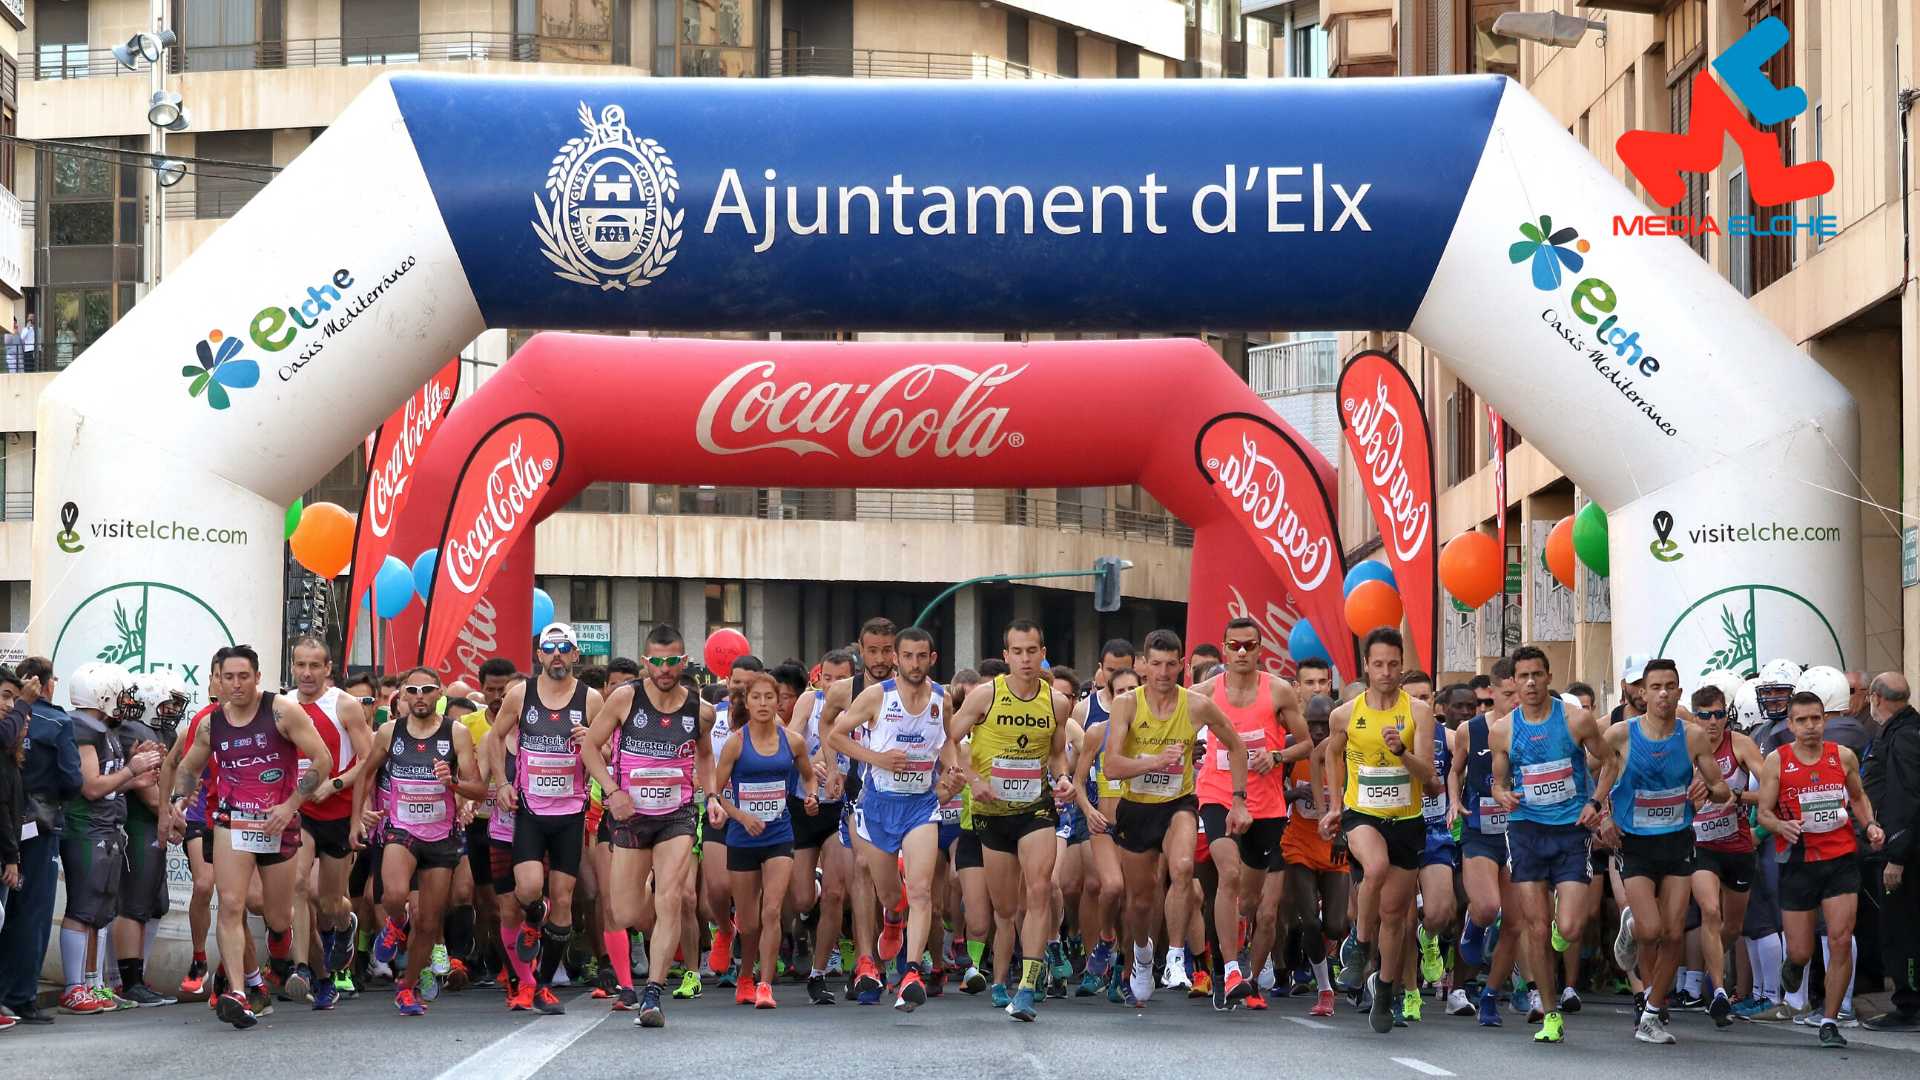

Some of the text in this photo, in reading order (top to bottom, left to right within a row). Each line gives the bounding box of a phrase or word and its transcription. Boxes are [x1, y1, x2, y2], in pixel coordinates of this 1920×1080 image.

[703, 163, 1373, 253] Ajuntament d’Elx
[249, 269, 355, 352] elche
[278, 255, 416, 382] Oasis Mediterráneo
[1570, 277, 1660, 378] elche
[1541, 308, 1678, 437] Oasis Mediterráneo
[91, 519, 248, 545] visitelche.com
[1688, 522, 1841, 544] visitelche.com
[996, 713, 1050, 729] mobel
[536, 776, 566, 787] 0020
[893, 771, 924, 784] 0074
[1143, 773, 1170, 785] 0013
[1003, 779, 1030, 791] 0017
[1366, 786, 1400, 798] 0549
[1533, 780, 1566, 796] 0092
[640, 787, 672, 799] 0052
[408, 803, 434, 814] 0021
[1647, 806, 1675, 817] 0091
[1814, 810, 1838, 823] 0241
